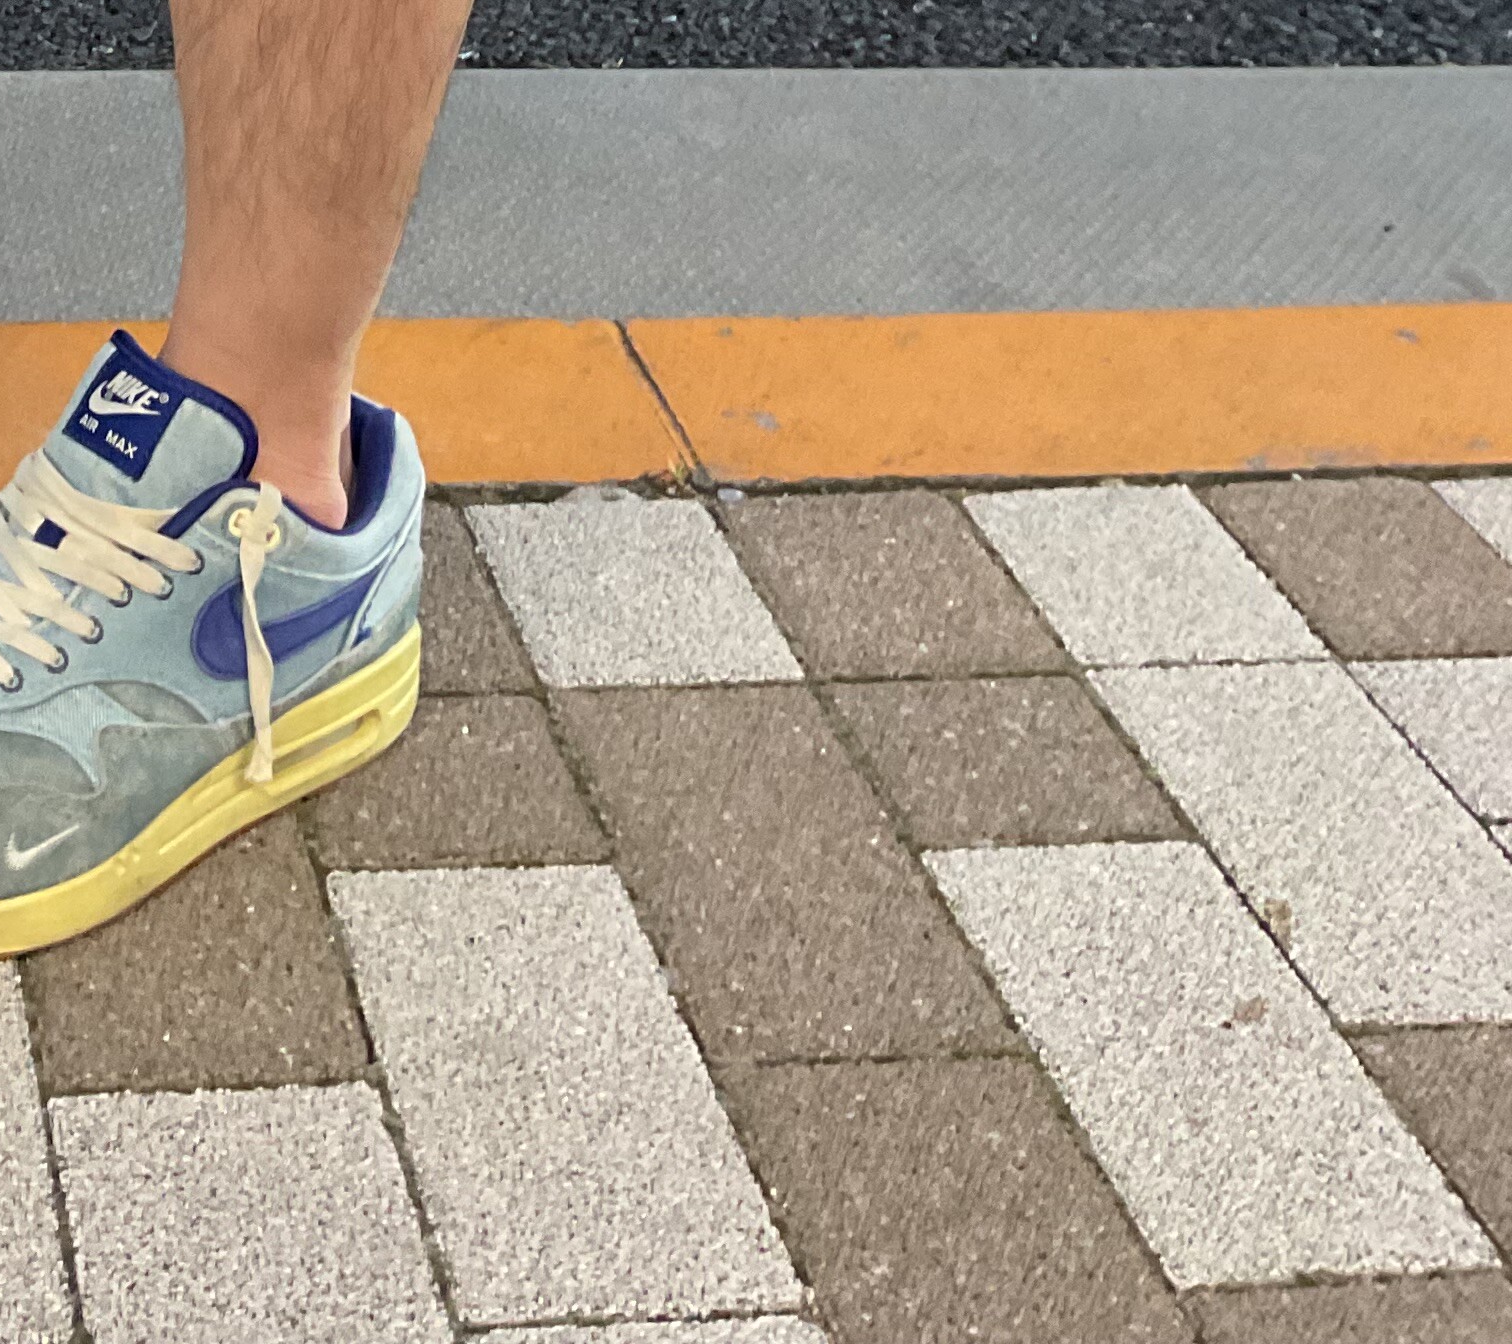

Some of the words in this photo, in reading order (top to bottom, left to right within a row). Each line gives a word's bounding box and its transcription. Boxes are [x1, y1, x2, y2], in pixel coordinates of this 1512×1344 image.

[107, 370, 160, 407] NIKE
[79, 414, 99, 433] AIR
[106, 430, 138, 459] MAX
